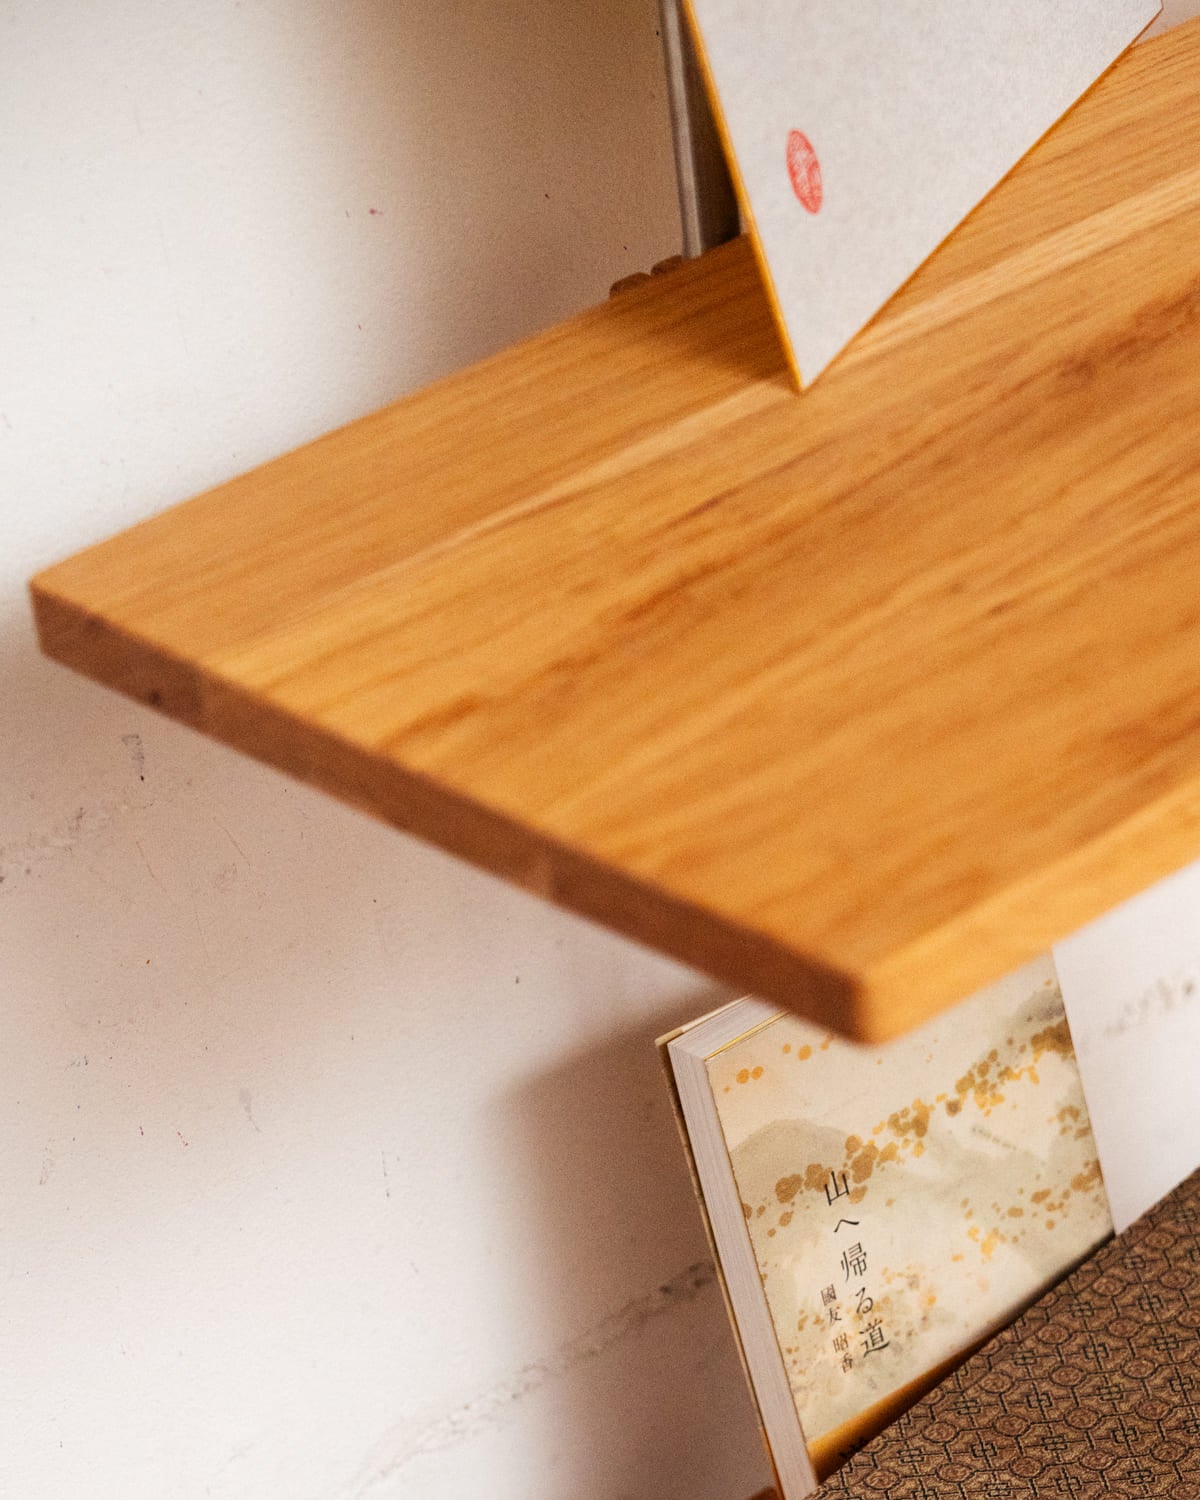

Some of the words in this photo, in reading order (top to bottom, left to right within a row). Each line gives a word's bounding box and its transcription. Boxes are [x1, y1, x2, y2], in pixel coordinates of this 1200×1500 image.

[823, 1170, 890, 1359] 山へ帰る道
